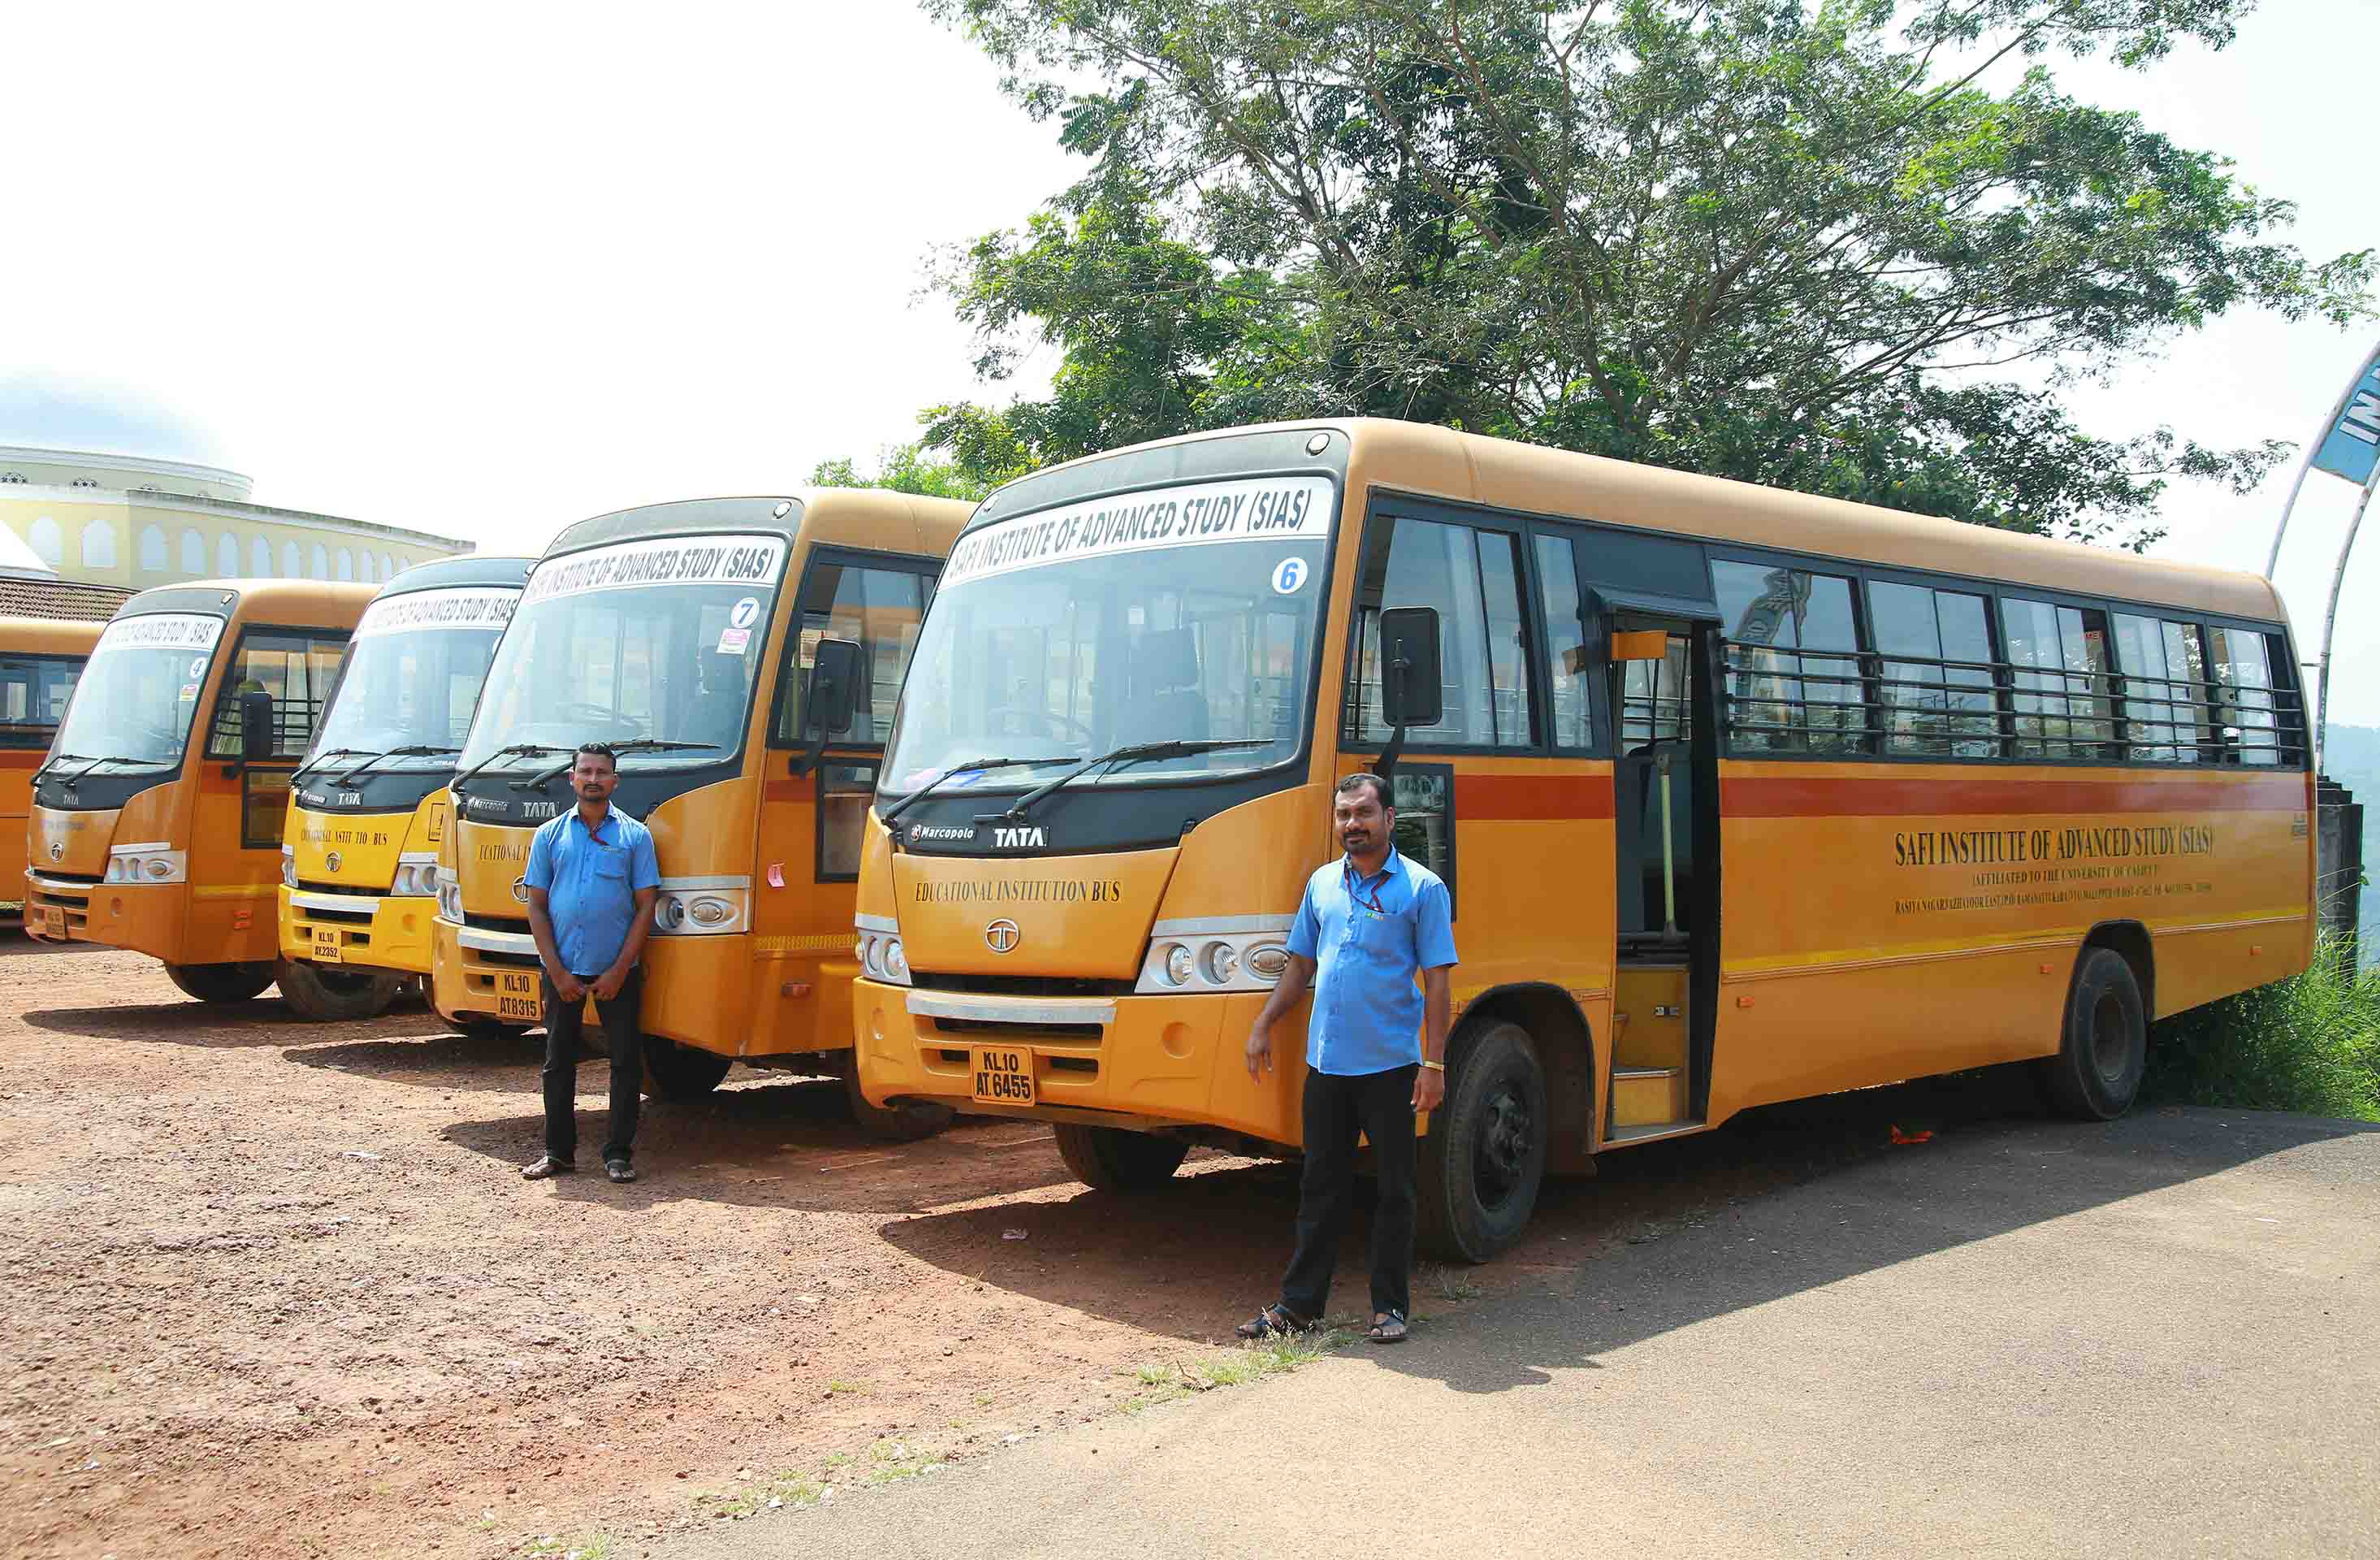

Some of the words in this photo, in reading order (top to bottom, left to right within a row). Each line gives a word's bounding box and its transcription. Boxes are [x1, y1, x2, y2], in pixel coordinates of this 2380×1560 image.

[2339, 364, 2380, 446] IN
[949, 539, 984, 578] SAFI
[983, 519, 1056, 567] INSTITUTE
[1054, 516, 1081, 553] OF
[1077, 501, 1178, 549] ADVANCED
[1177, 492, 1247, 537] STUDY
[1247, 488, 1313, 532] (SIAS)
[595, 556, 617, 585] OF
[610, 549, 681, 583] ADVANCED
[675, 547, 727, 579] STUDY
[721, 547, 775, 579] (SIAS)
[1279, 561, 1300, 590] 6
[456, 597, 491, 622] STUDY
[738, 603, 755, 625] 7
[194, 661, 203, 675] 4
[338, 792, 362, 806] TATA
[524, 801, 557, 818] TATA
[373, 832, 388, 846] BUS
[920, 827, 974, 840] Marcopolo
[994, 827, 1047, 847] TATA
[1895, 831, 1936, 867] SAFI
[1940, 830, 2027, 864] INSTITUTE
[2031, 830, 2051, 860] OF
[2057, 827, 2131, 859] ADVANCED
[2135, 826, 2176, 856] STUDY
[2178, 825, 2214, 855] (SIAS)
[2029, 870, 2041, 883] TO
[2043, 869, 2060, 882] THE
[2061, 865, 2111, 881] UNIVERSITY
[915, 881, 993, 902] EDUCATIONAL
[995, 879, 1087, 902] INSTITUTION
[1091, 880, 1121, 902] BUS
